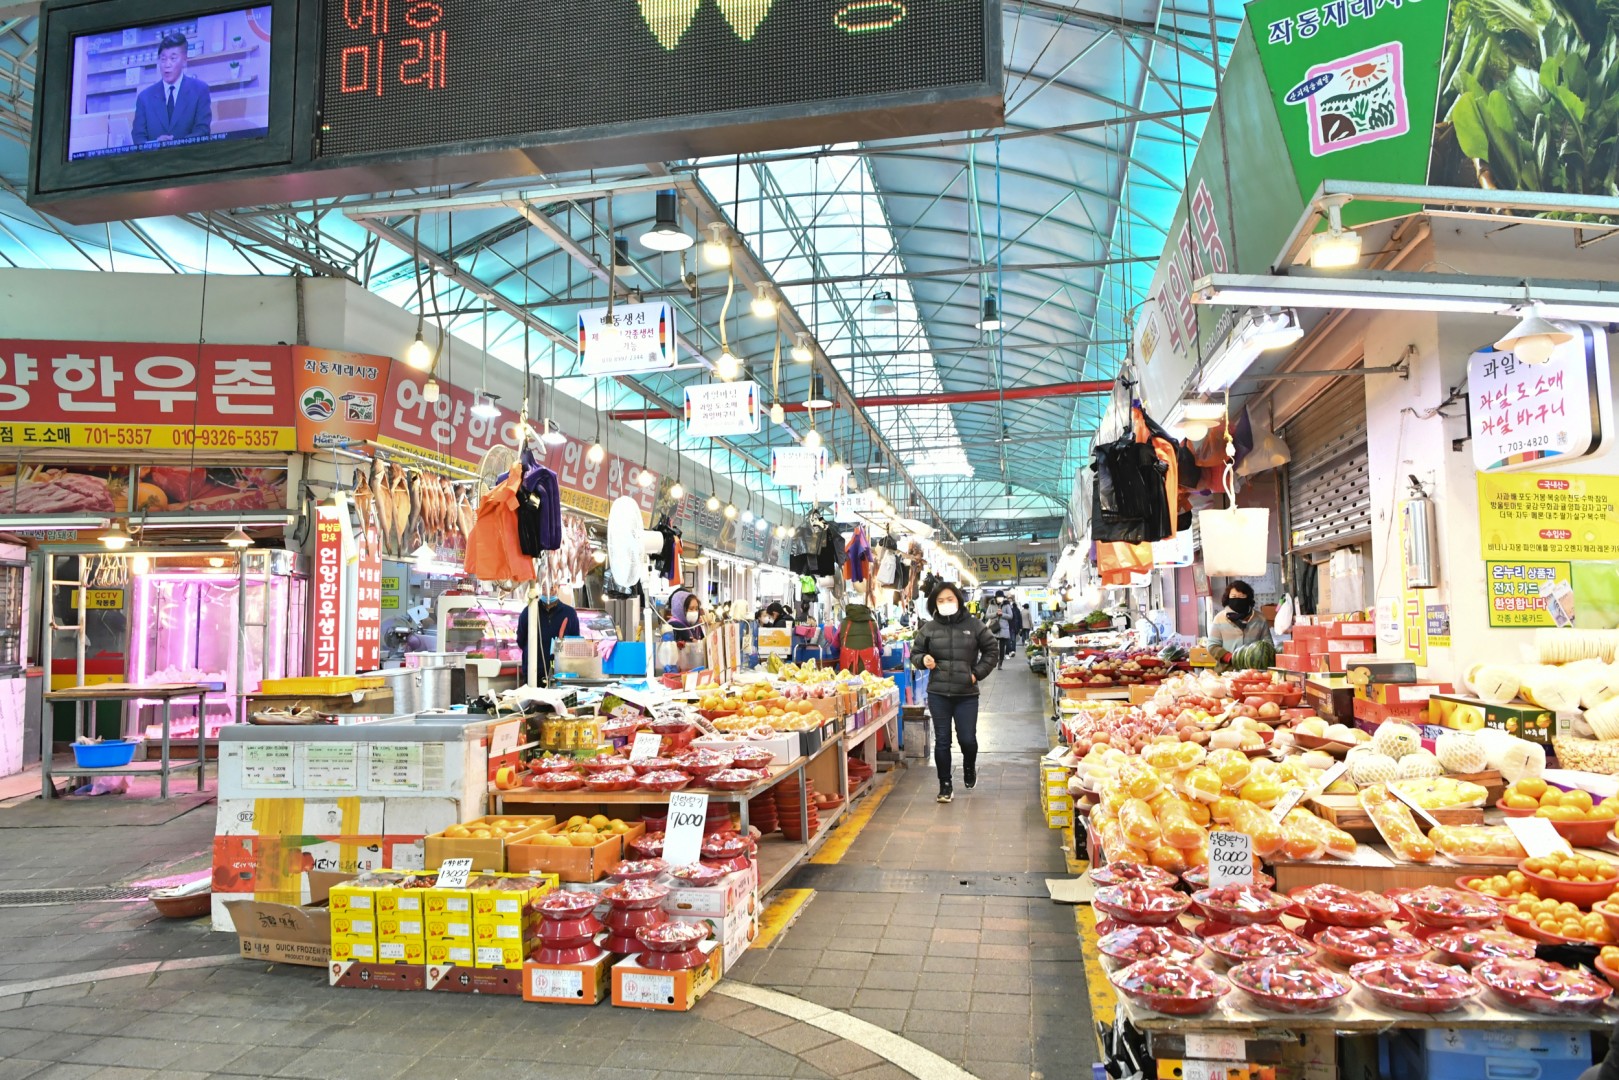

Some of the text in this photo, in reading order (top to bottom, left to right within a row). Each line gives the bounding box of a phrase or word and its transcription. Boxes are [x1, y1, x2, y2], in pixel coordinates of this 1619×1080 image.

[1268, 0, 1423, 44] 좌동재래
[341, 30, 446, 96] 미래
[304, 359, 378, 380] 좌동재래시장
[1480, 383, 1511, 409] 과일
[1481, 397, 1565, 435] 과일 바구니
[24, 427, 70, 443] 도.소매
[84, 427, 152, 445] 701-5357
[173, 429, 279, 447] 010-9326-5357
[1508, 435, 1549, 452] 703-4820
[1493, 566, 1556, 579] 온누리 상품권
[1494, 582, 1539, 594] 전자 카드
[1495, 597, 1547, 610] 환영합니다
[1514, 614, 1544, 623] 신용카드
[240, 811, 254, 821] 230
[671, 812, 703, 828] 7000
[276, 943, 295, 952] QUICK
[297, 944, 321, 954] FROZEN
[285, 953, 304, 961] PRODUCT
